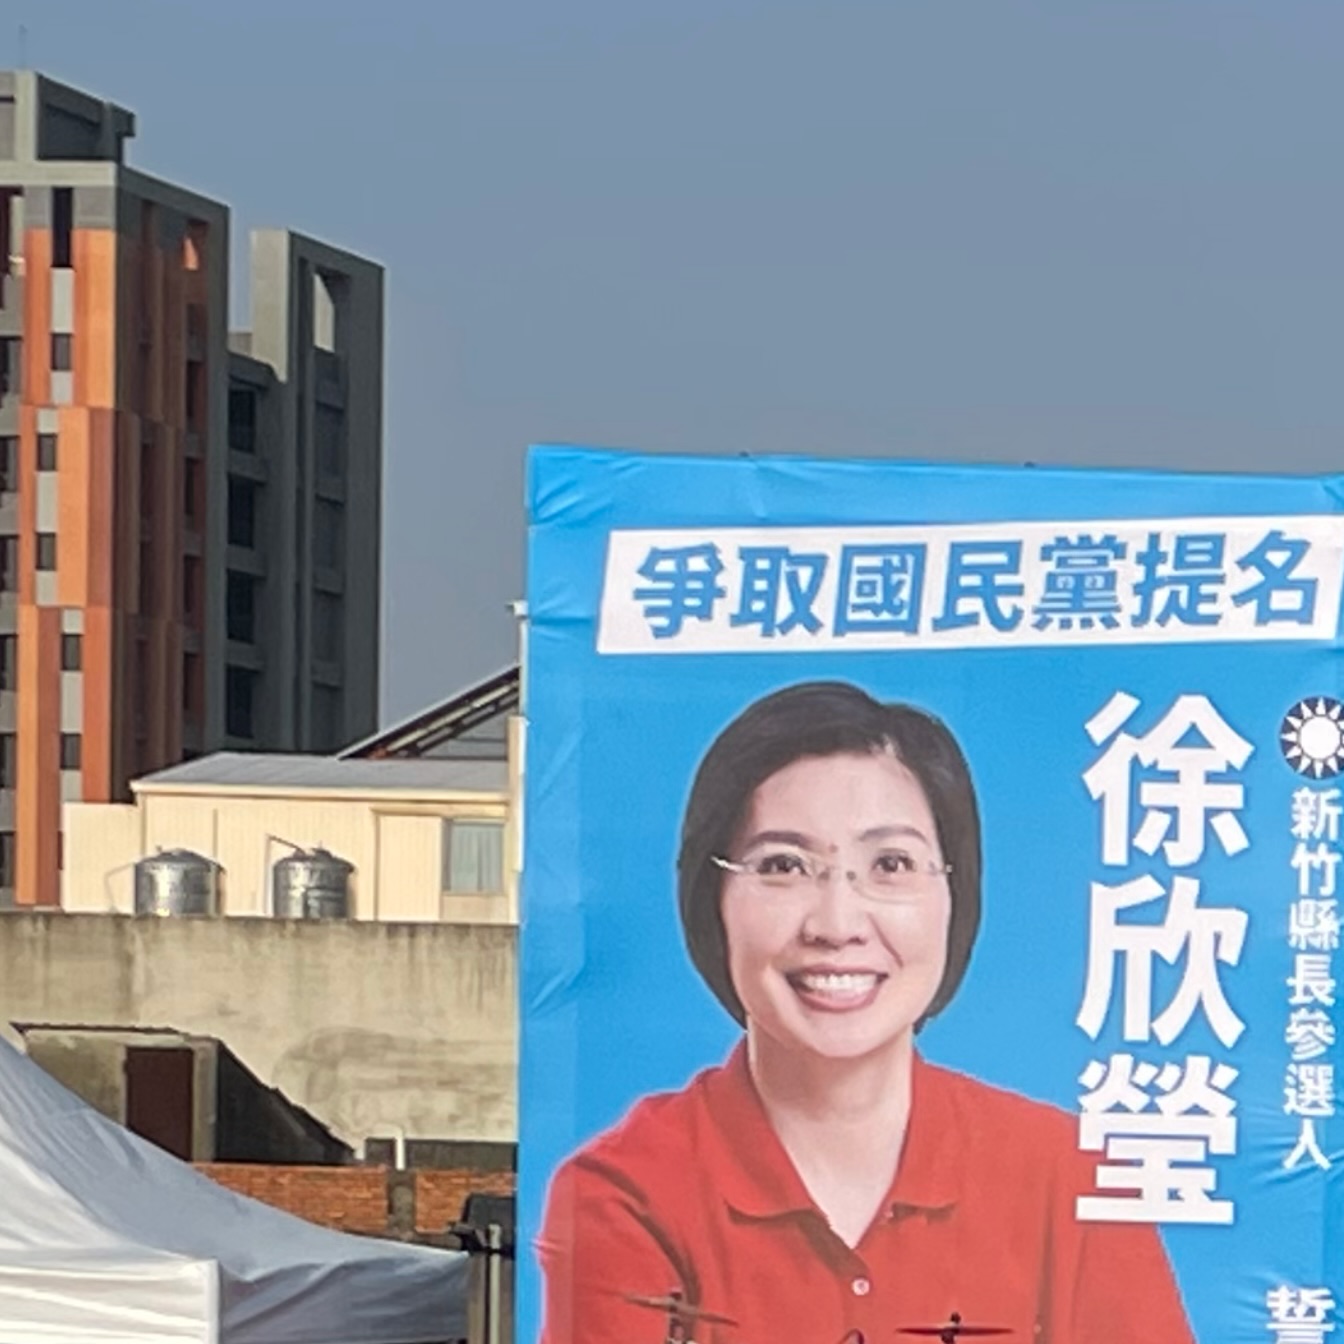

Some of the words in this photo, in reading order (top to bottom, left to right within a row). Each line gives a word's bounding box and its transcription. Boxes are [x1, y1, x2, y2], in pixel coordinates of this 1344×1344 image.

[633, 529, 1322, 639] 爭取國民黨提名
[1076, 690, 1255, 1226] 徐欣瑩
[1281, 787, 1344, 1172] 新竹縣長參選人
